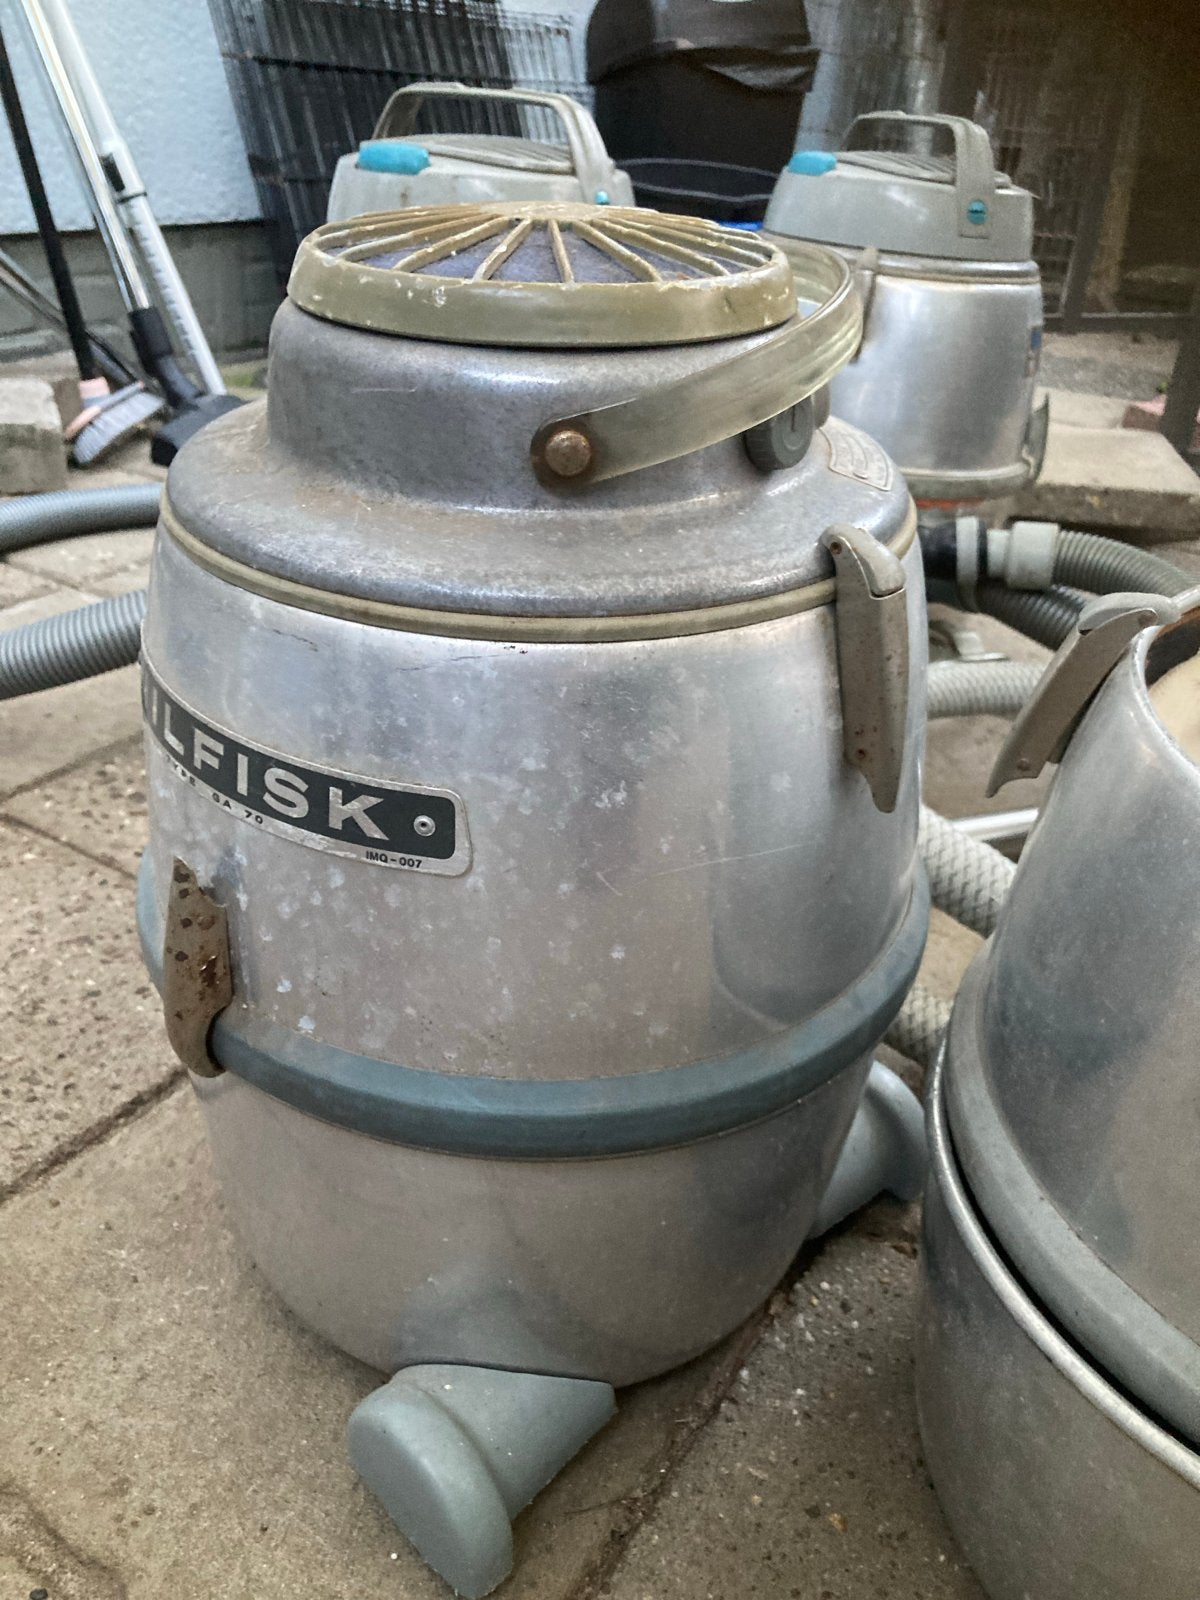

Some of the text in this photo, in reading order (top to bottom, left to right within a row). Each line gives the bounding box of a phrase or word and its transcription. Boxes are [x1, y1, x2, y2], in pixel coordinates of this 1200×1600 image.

[144, 675, 389, 841] ILFISK
[244, 809, 264, 825] 70
[366, 850, 422, 868] IMQ-007
